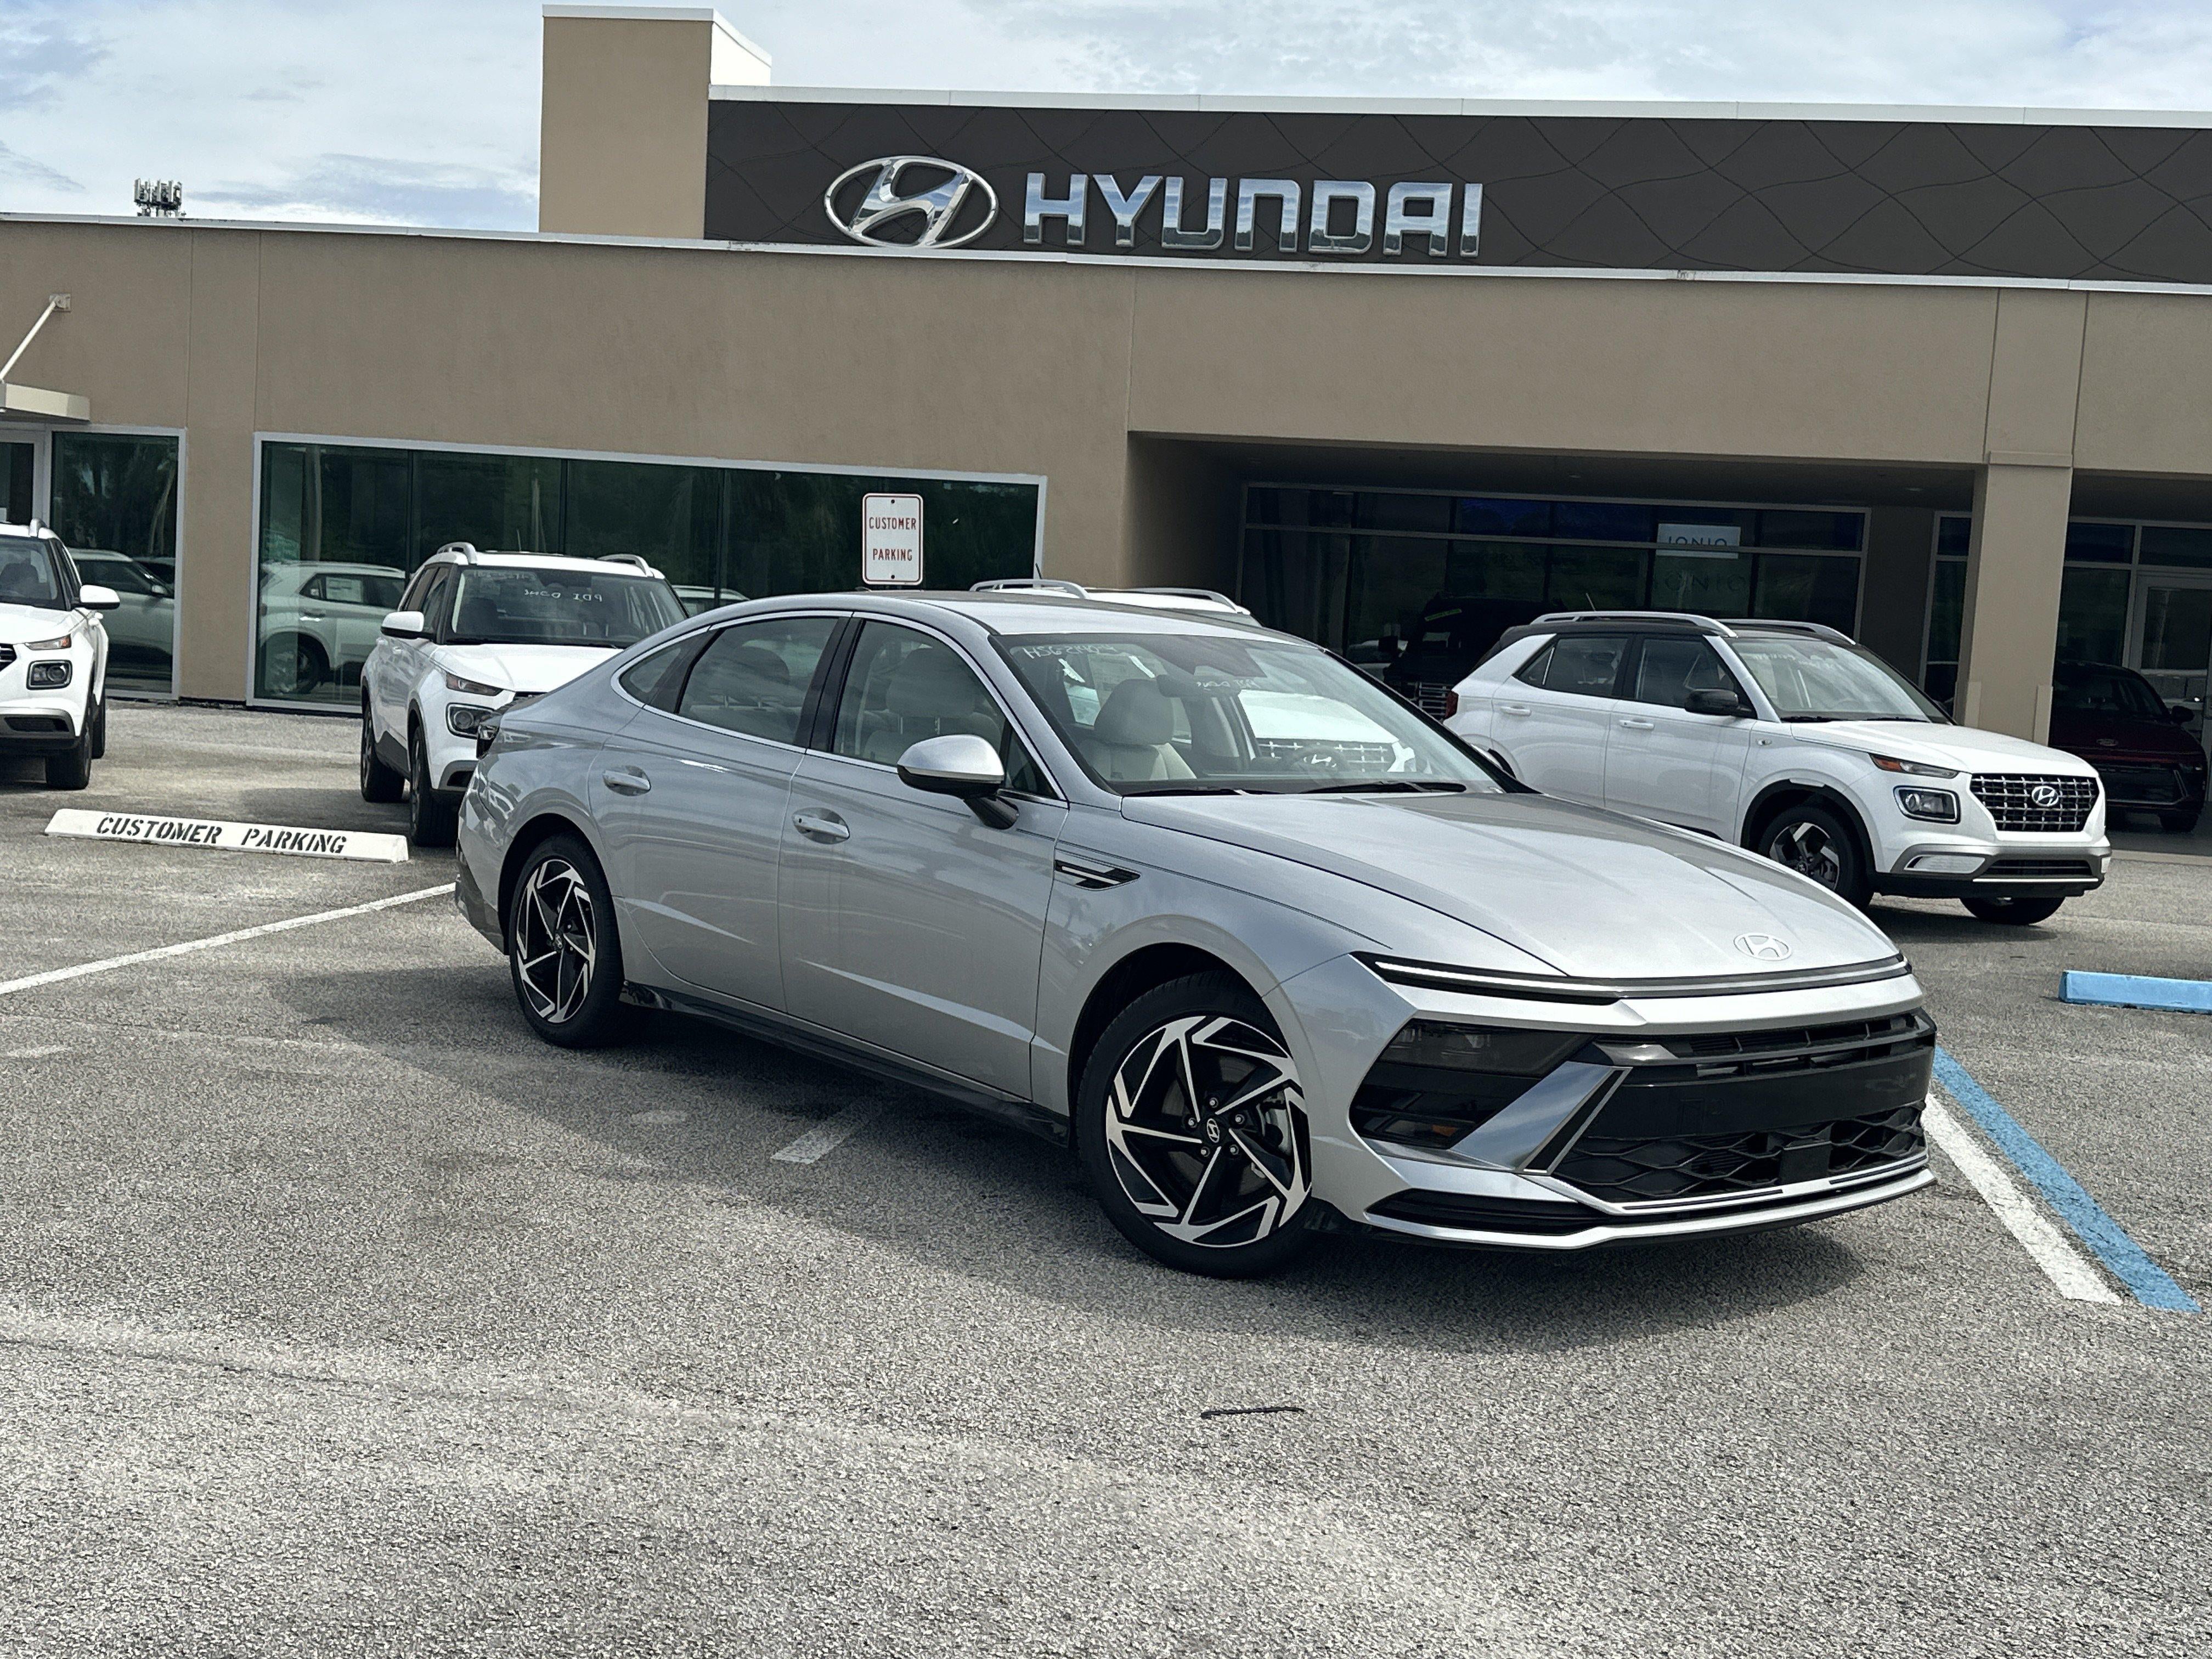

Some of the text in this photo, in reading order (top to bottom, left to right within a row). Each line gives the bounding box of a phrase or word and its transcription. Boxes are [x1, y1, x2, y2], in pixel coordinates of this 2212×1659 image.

[1023, 172, 1483, 257] HYUNDAI
[869, 517, 917, 531] CUSTOMER
[872, 548, 913, 562] PARKING
[96, 816, 347, 854] CUSTOMER PARKING
